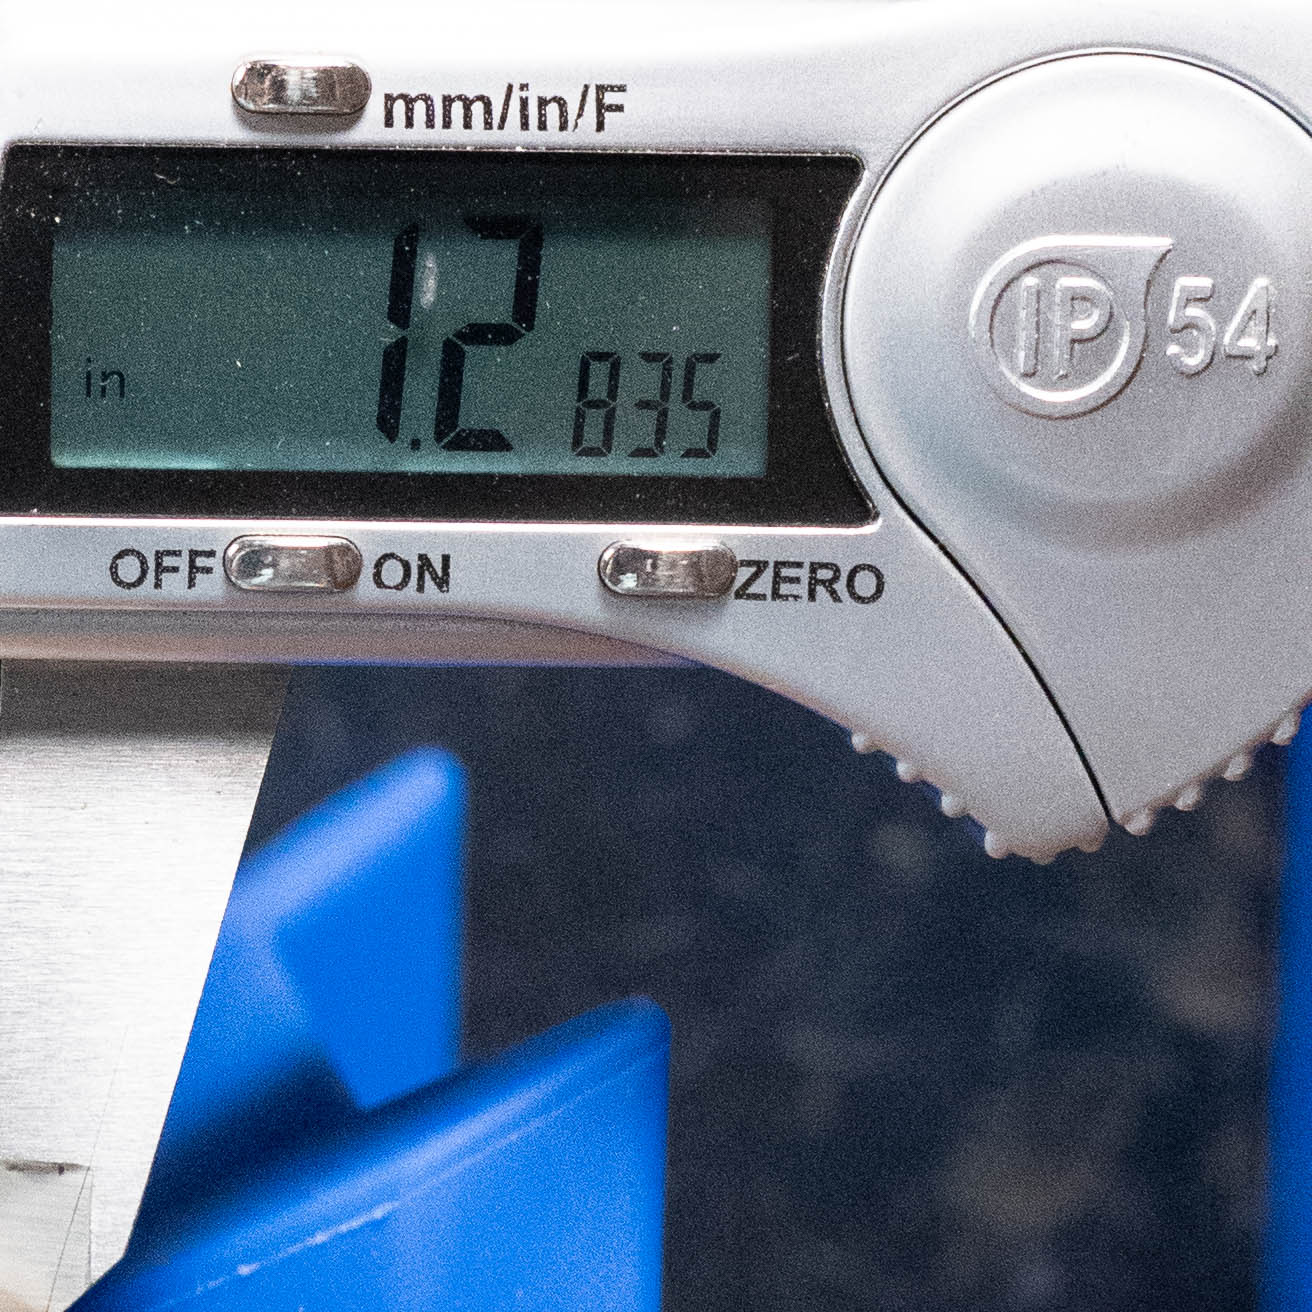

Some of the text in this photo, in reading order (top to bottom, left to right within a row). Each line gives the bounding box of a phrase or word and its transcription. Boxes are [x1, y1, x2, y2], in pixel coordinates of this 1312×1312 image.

[383, 83, 627, 133] mm/in/F
[1017, 275, 1279, 379] IP 54
[84, 356, 126, 399] in
[108, 548, 451, 594] OFF ON
[733, 559, 886, 605] ZERO
